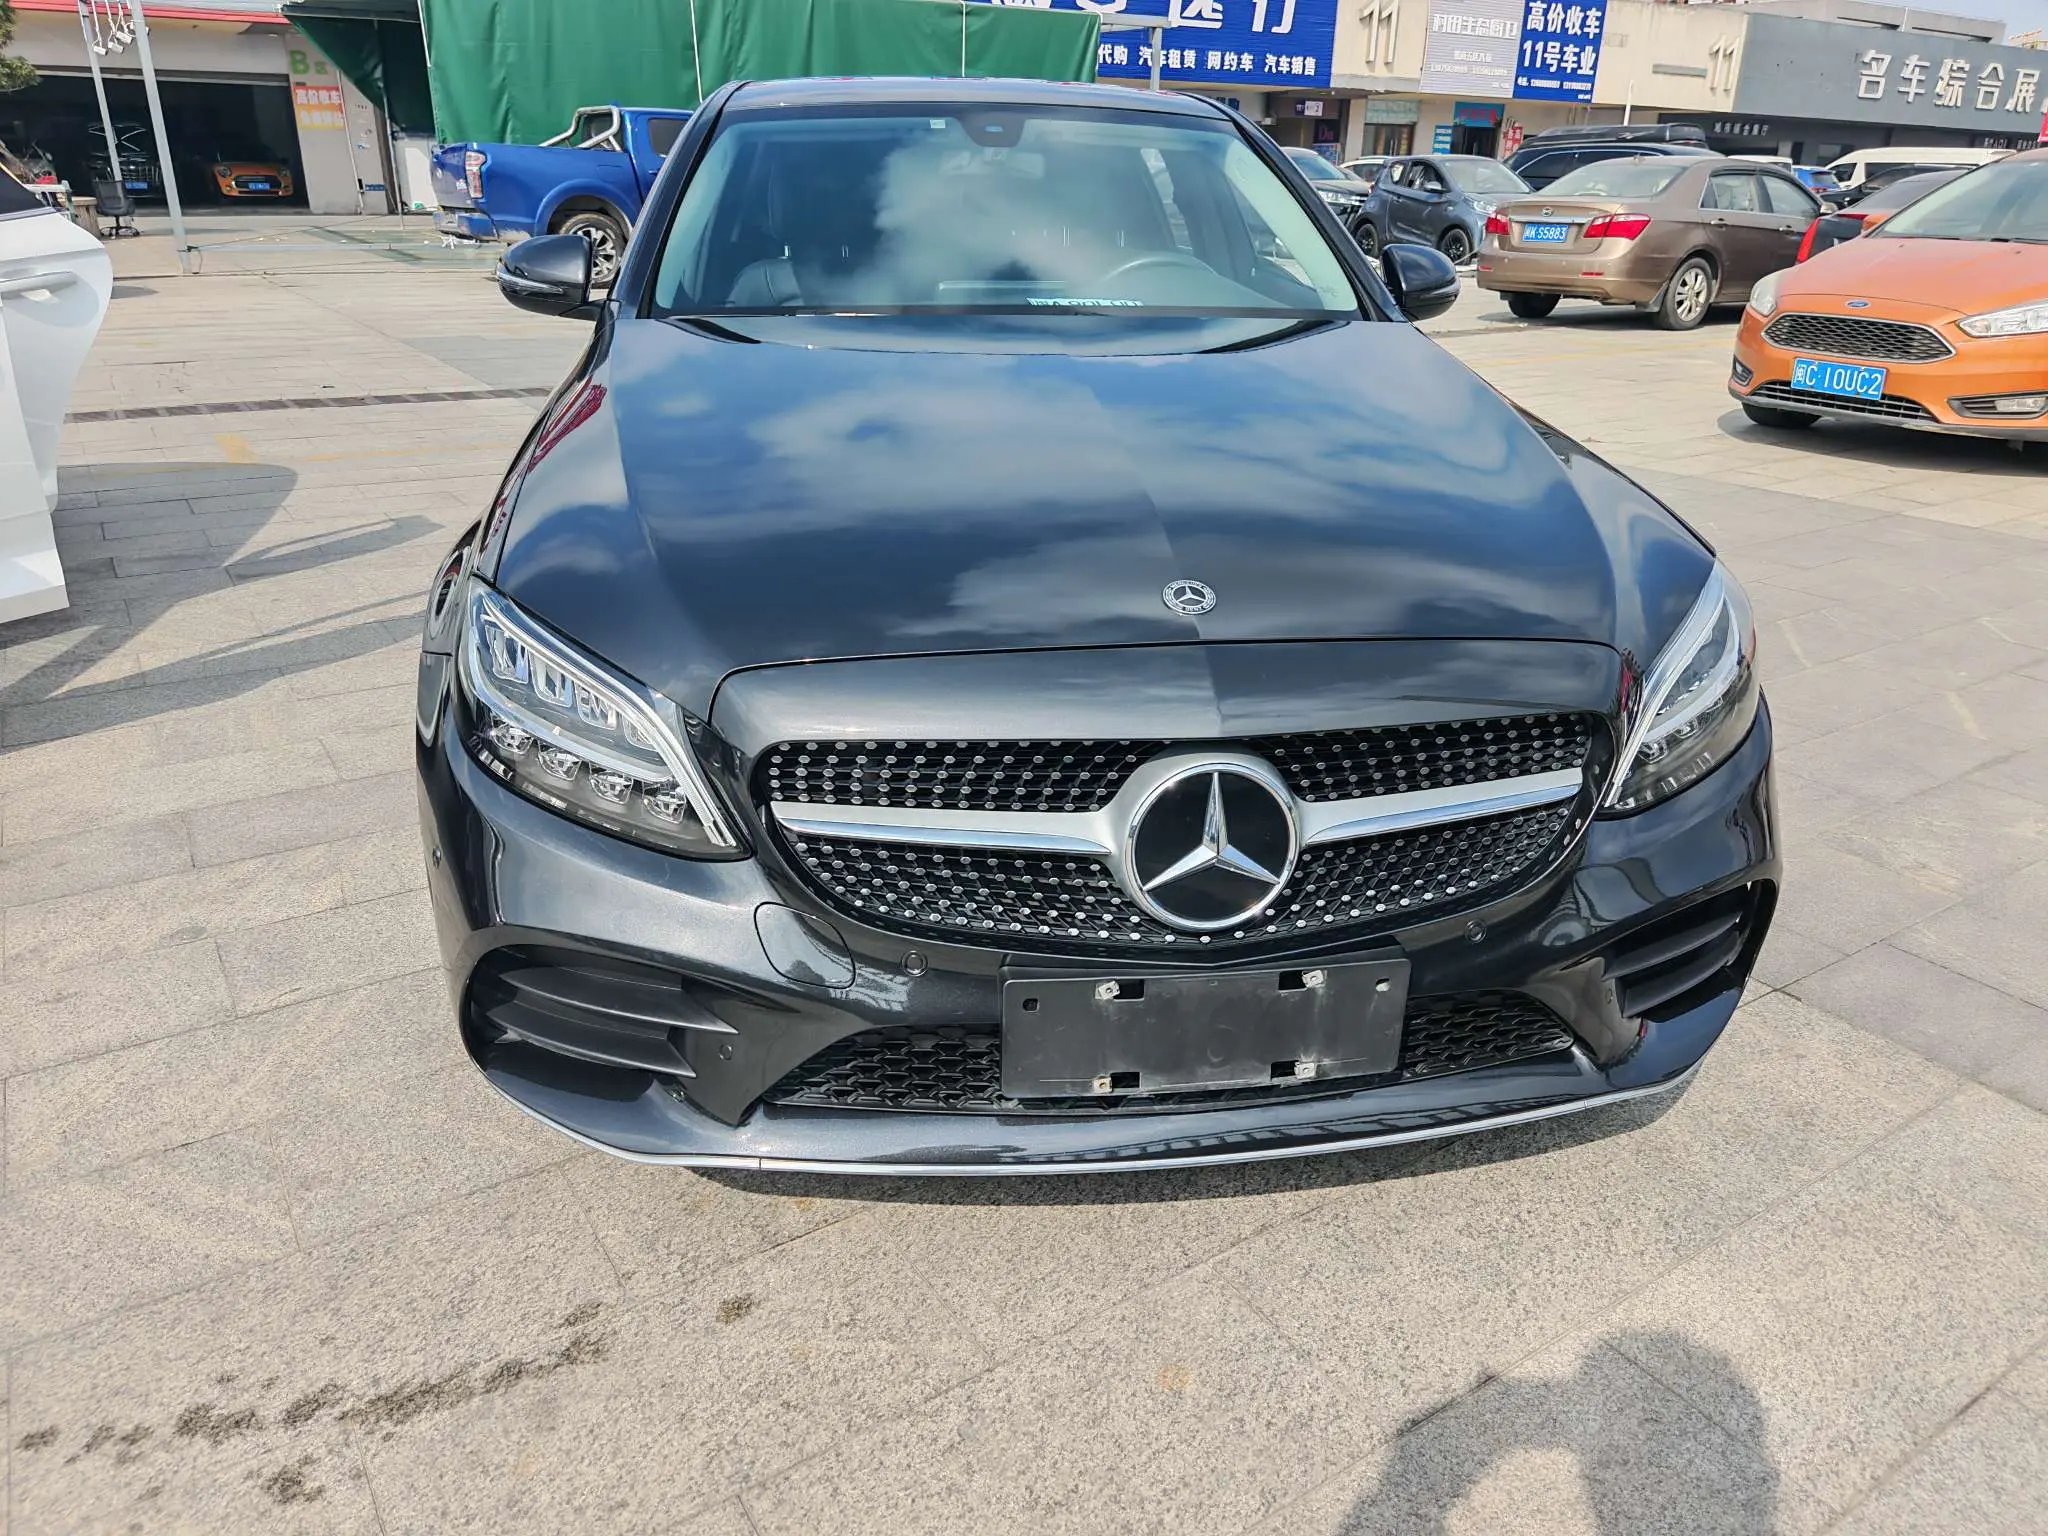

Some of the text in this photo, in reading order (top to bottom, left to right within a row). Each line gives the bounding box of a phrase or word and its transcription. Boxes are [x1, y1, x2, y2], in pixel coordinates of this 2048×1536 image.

[1360, 0, 1399, 64] 11
[1526, 1, 1602, 39] 高价收车
[1097, 43, 1128, 66] 代购
[1207, 50, 1254, 72] 网约车
[1264, 52, 1316, 76] 汽车销售
[1523, 40, 1596, 75] 11号车业
[1709, 34, 1740, 91] 11
[1857, 49, 2048, 114] 名车综合展
